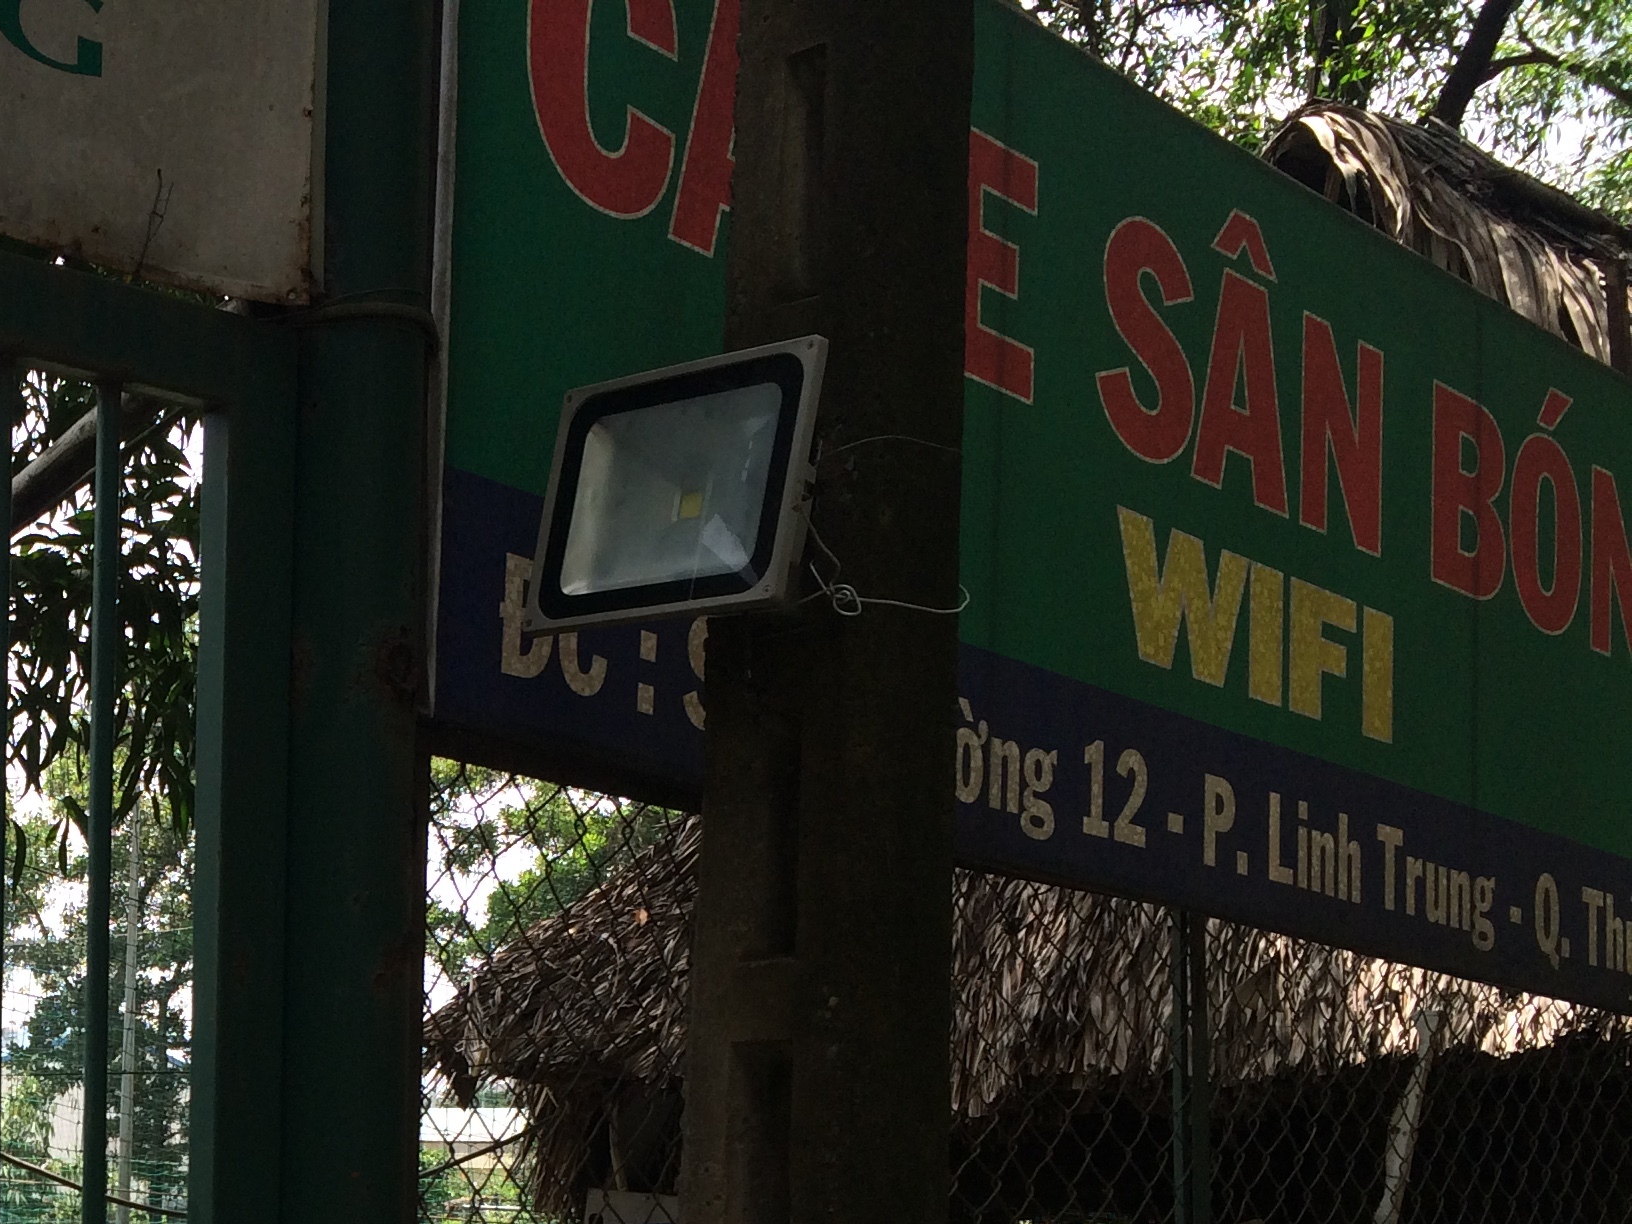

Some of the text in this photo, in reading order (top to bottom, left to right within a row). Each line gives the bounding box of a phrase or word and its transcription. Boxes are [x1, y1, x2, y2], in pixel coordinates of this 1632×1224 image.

[1095, 208, 1385, 558] SÂN
[1431, 379, 1632, 658] BÓN
[1116, 503, 1395, 744] WIFI
[954, 696, 1059, 841] ờng
[1082, 738, 1149, 850] 12
[1203, 772, 1250, 876] P.
[1268, 790, 1362, 905] Linh
[1376, 822, 1496, 952] Trung
[1534, 872, 1570, 971] Q.
[1581, 885, 1632, 977] Th
